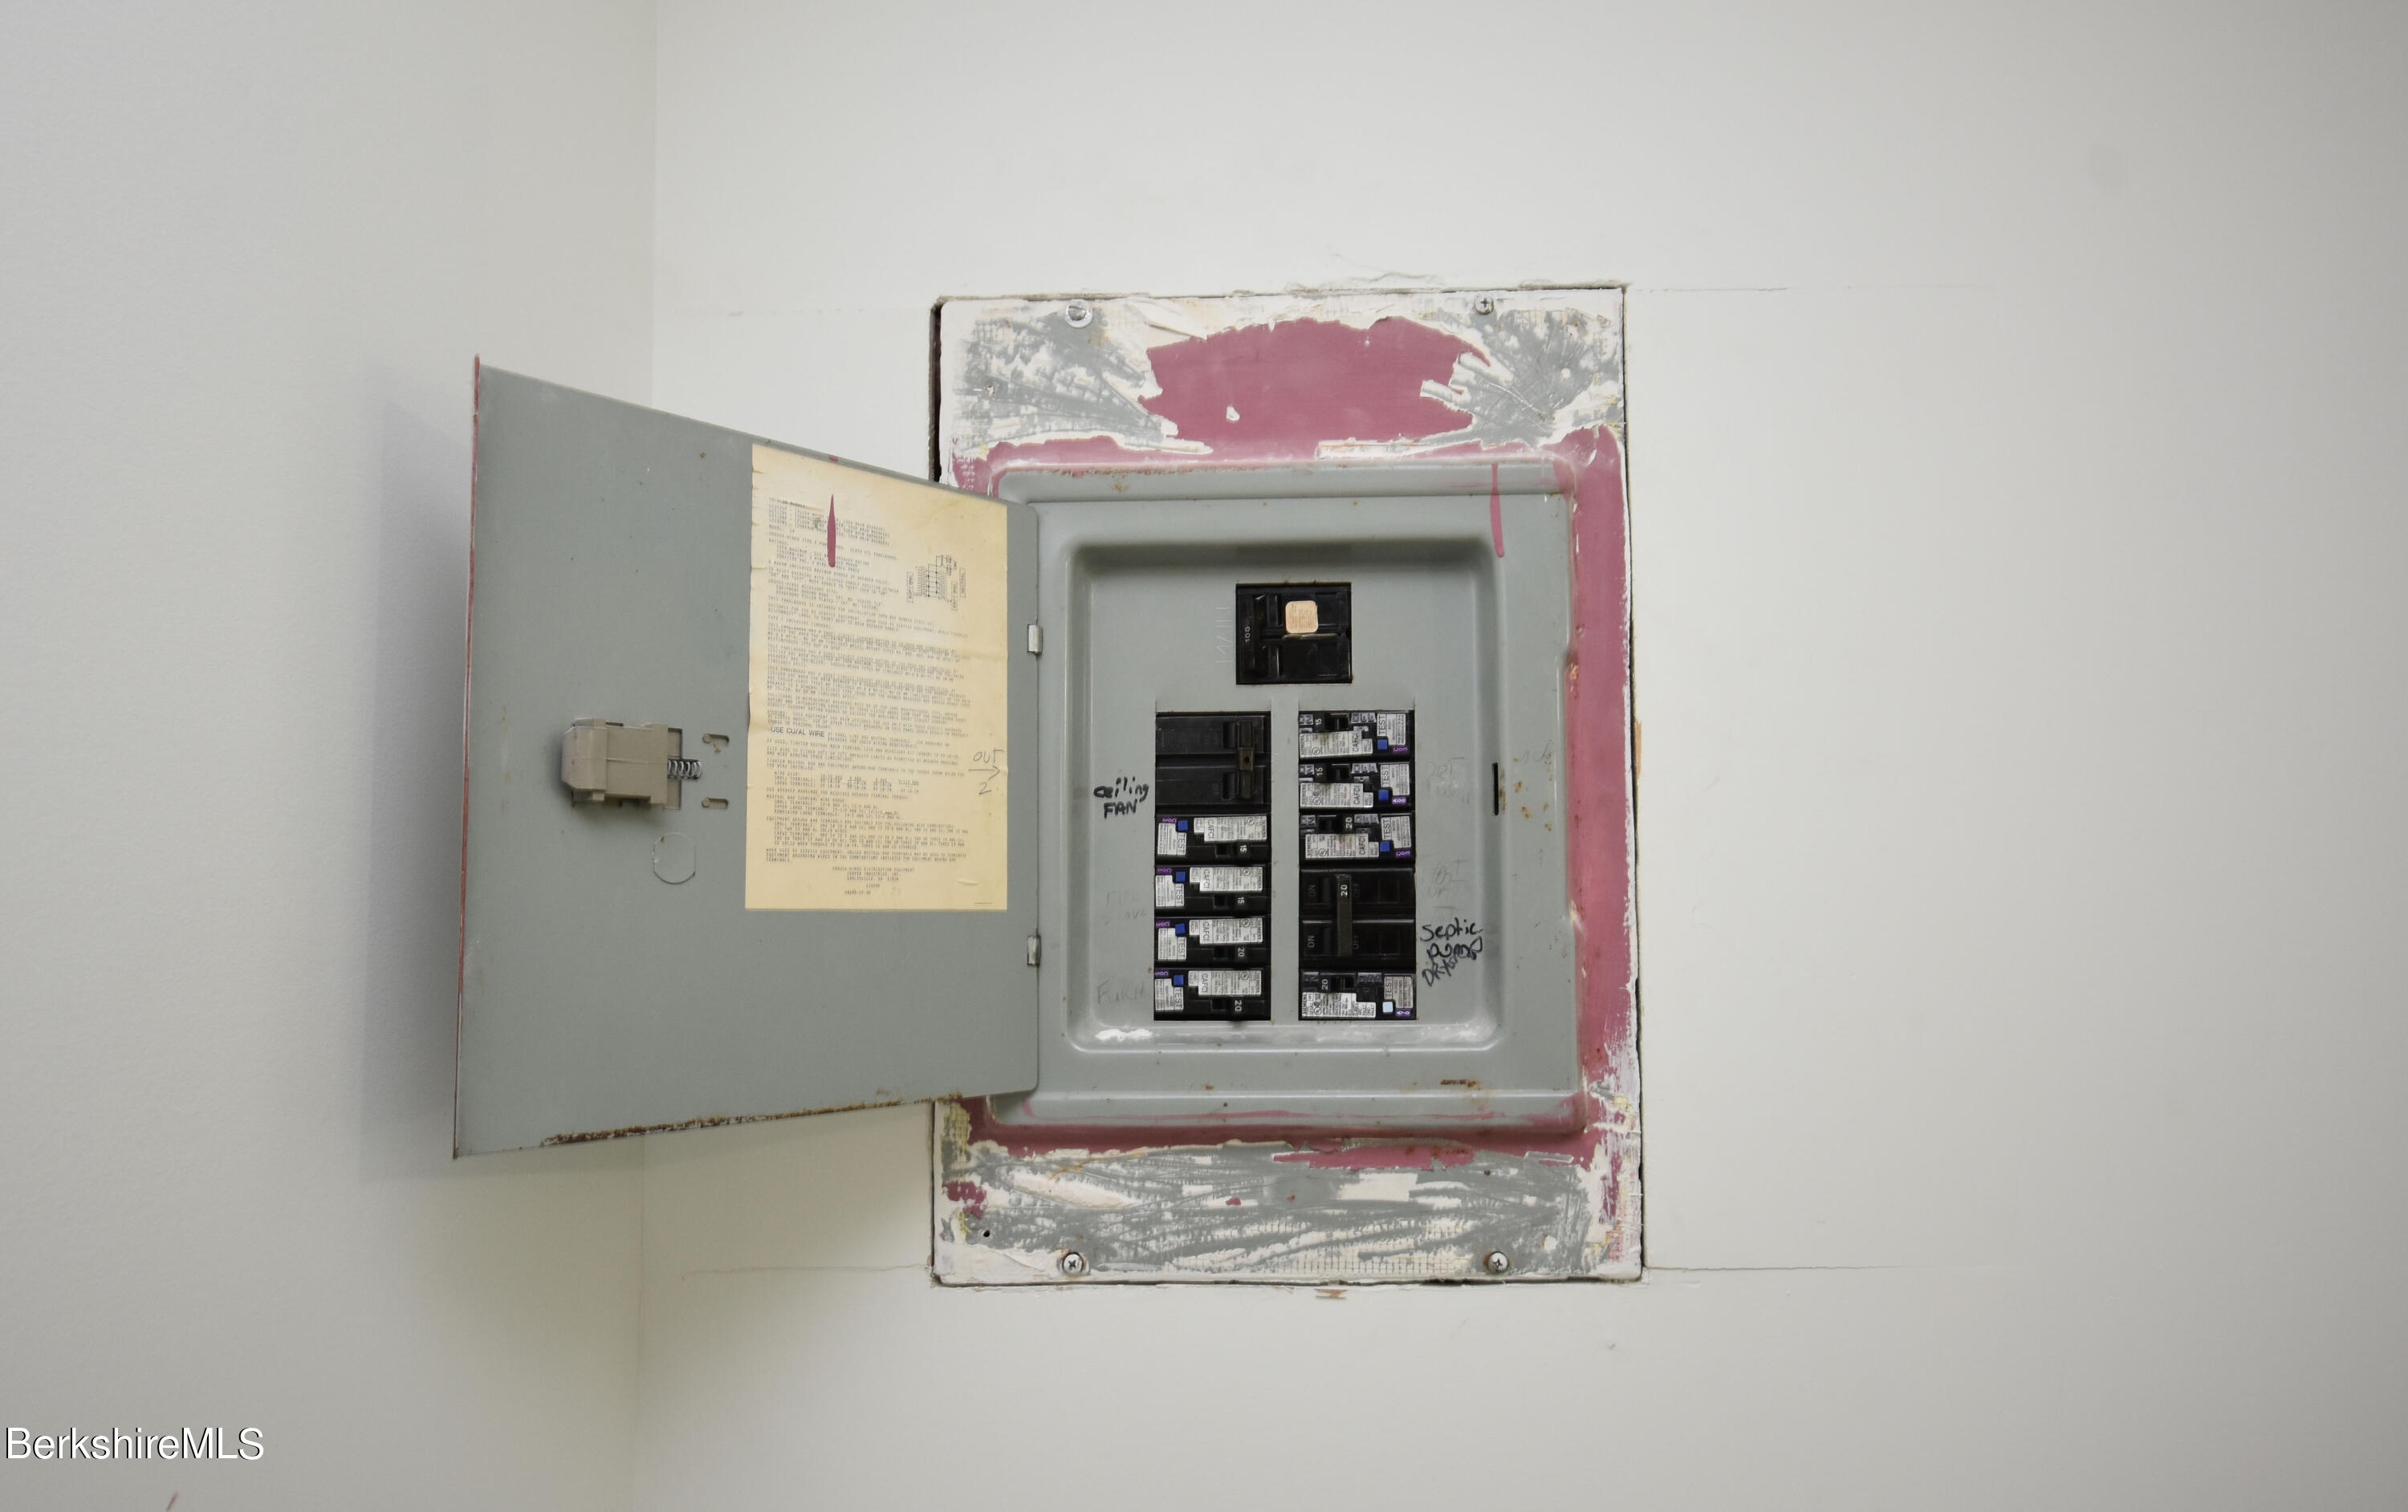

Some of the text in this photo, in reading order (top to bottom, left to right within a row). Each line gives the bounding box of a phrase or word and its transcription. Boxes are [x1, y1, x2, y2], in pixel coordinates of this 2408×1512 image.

[1378, 713, 1387, 735] TEST
[787, 727, 807, 736] CU/AL
[808, 730, 825, 738] WIRE
[973, 749, 1003, 763] OUT
[1316, 767, 1324, 776] 15
[1381, 764, 1389, 786] TEST
[978, 782, 992, 795] 2
[1104, 799, 1137, 819] FAN
[1345, 817, 1353, 829] 20
[1382, 818, 1391, 839] TEST
[1178, 833, 1186, 854] TEST
[1239, 844, 1247, 853] 15
[1202, 868, 1210, 888] CAFCI
[1176, 884, 1184, 905] TEST
[1340, 884, 1348, 897] 20
[1238, 896, 1245, 905] 15
[1420, 917, 1483, 942] Septic
[1178, 937, 1186, 958] TEST
[1307, 935, 1315, 949] ON
[1238, 947, 1245, 957] 20
[1201, 973, 1209, 993] CAFCI
[1321, 978, 1328, 990] 20
[1174, 987, 1182, 1009] TEST
[1235, 1000, 1243, 1012] 20
